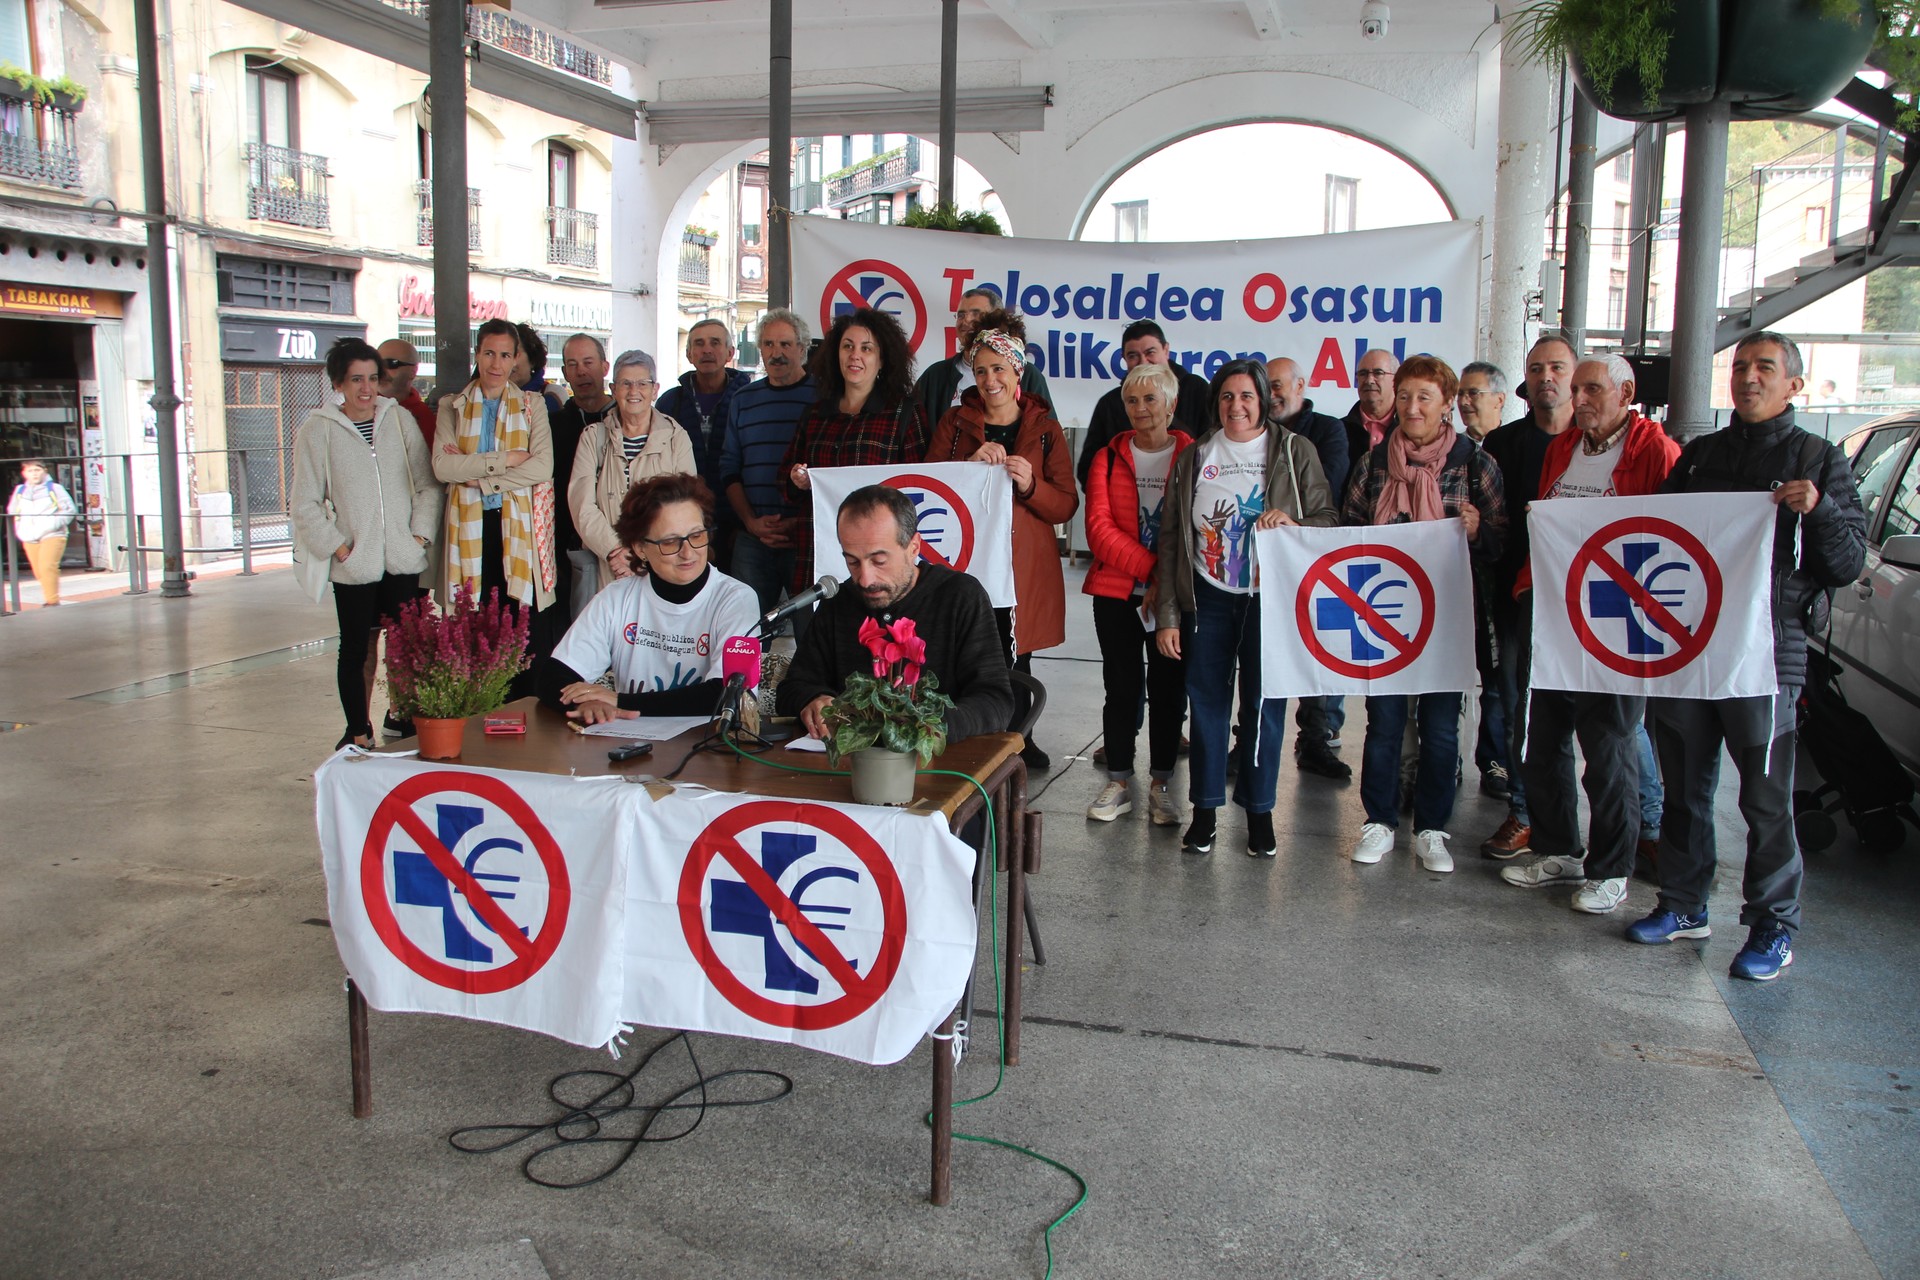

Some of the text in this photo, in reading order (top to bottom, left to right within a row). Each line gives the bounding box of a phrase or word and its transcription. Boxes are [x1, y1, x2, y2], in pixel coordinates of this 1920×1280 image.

[7, 288, 91, 308] TABAKOAK
[1243, 272, 1442, 323] Osasun
[635, 638, 662, 650] defenda
[639, 627, 695, 644] Osasun publikoa
[726, 647, 756, 655] KANALA
